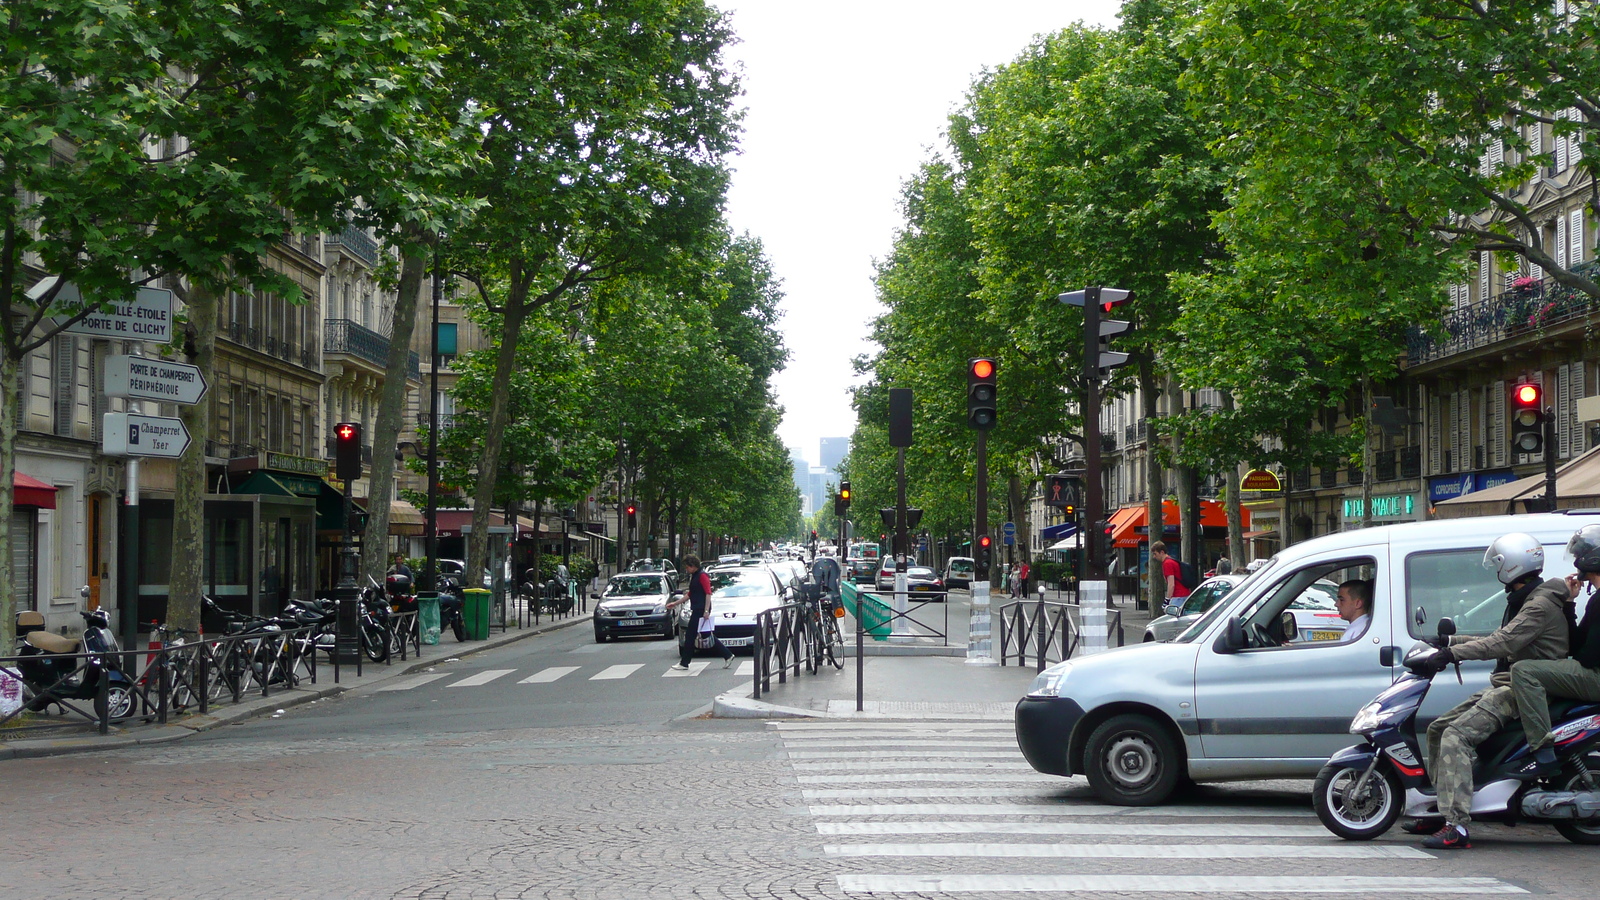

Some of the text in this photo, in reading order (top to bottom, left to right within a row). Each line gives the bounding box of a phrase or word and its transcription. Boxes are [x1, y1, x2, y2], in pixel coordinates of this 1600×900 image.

[81, 317, 166, 336] PORTE DE CLICHY
[130, 363, 195, 383] PORTE DE CHAMPERRET
[130, 377, 179, 395] PÉRIPHÉRIQUE
[131, 422, 180, 441] P Champerret
[152, 438, 170, 450] Yser
[1353, 496, 1402, 517] PHRMACIE
